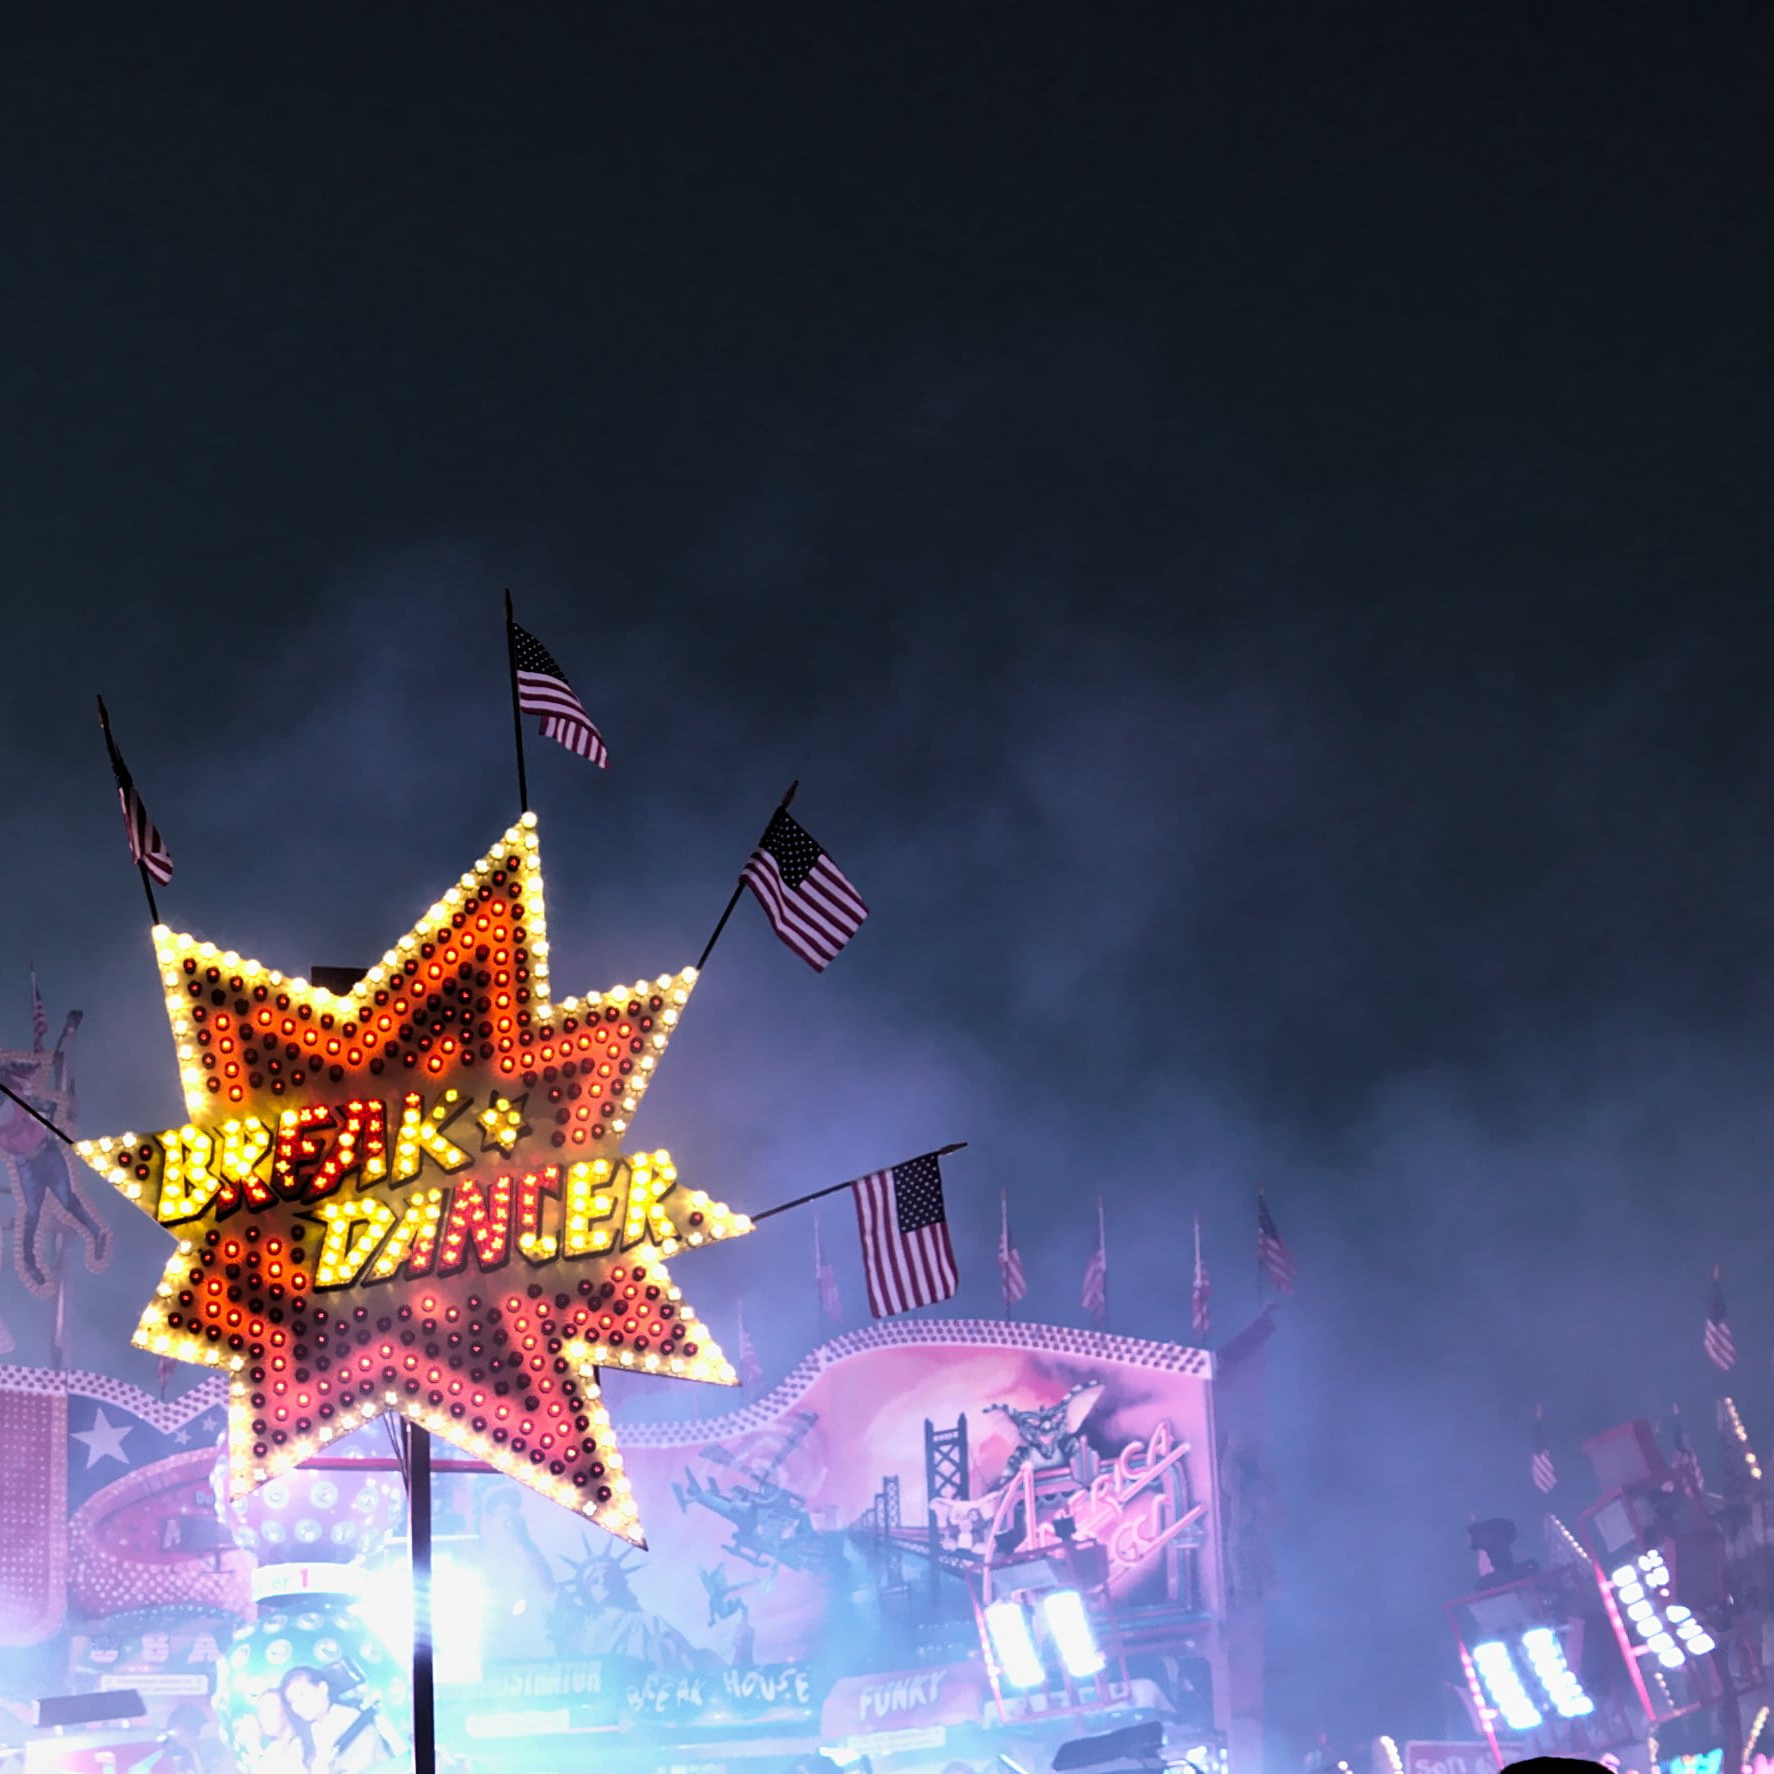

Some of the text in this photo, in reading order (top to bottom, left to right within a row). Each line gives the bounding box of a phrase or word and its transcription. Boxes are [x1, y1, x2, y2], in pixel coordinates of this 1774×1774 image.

[157, 1087, 473, 1224] BREAK
[313, 1148, 679, 1292] DANCER
[723, 1664, 811, 1704] HOUSE
[858, 1670, 948, 1721] FUNKY
